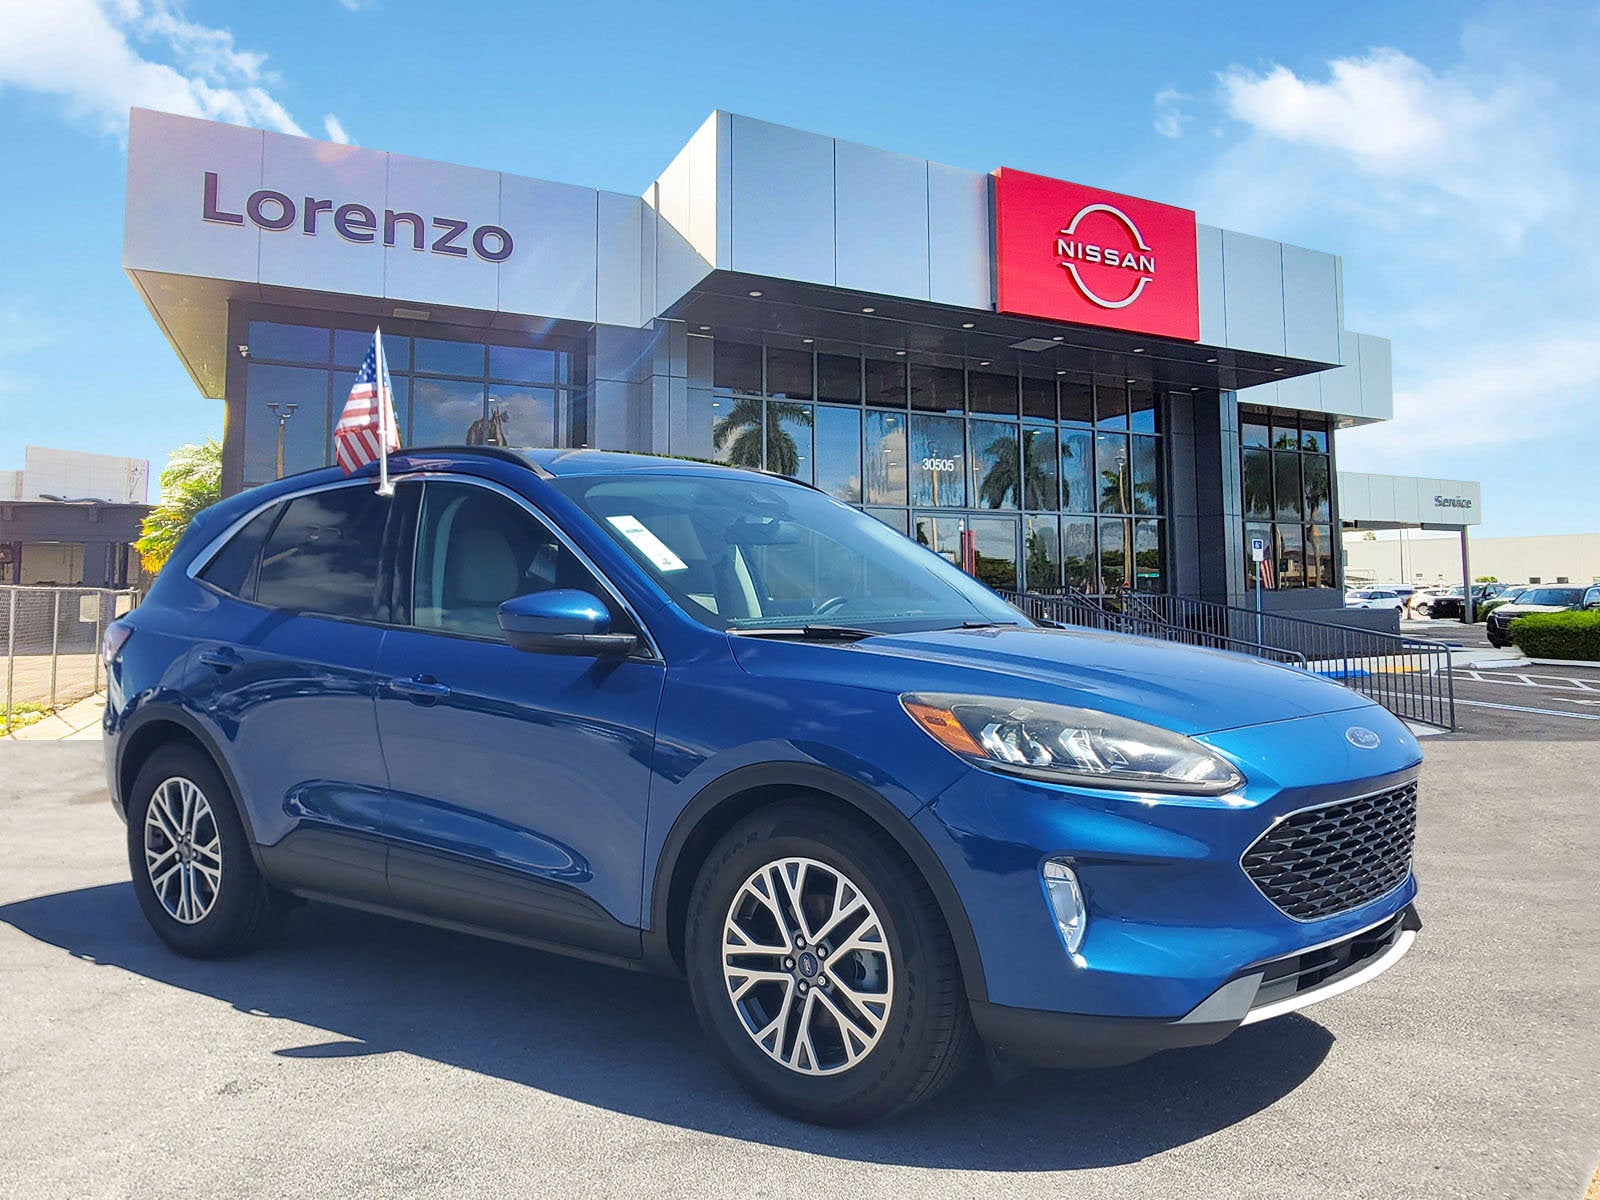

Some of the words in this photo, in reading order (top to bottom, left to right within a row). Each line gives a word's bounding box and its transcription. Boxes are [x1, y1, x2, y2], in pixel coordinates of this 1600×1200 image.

[202, 171, 514, 262] Lorenzo
[1057, 238, 1155, 273] NISSAN
[922, 457, 954, 471] 30505
[1434, 495, 1472, 508] Service
